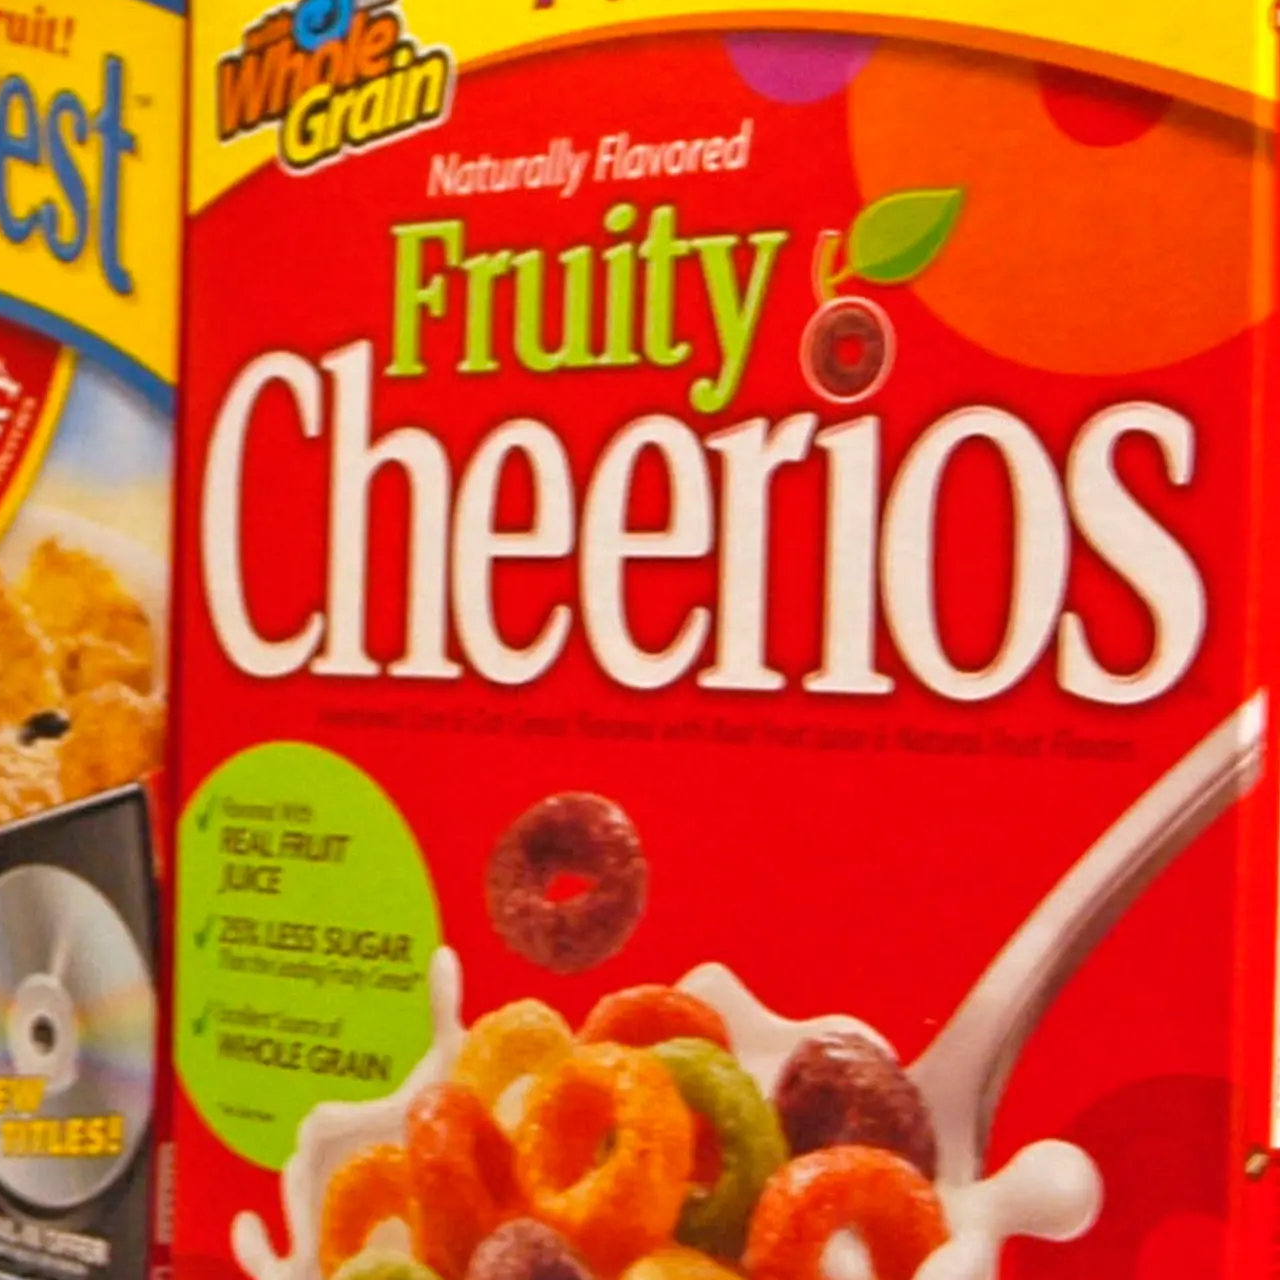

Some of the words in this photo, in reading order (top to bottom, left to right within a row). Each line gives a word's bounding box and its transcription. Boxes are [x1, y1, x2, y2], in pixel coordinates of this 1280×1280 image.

[218, 8, 402, 144] Whole
[282, 42, 452, 171] Grain
[426, 138, 587, 201] Naturally
[593, 120, 753, 188] Flavored
[384, 203, 789, 414] Fruity
[200, 340, 1210, 707] Cheerios
[217, 863, 284, 896] JUICE
[278, 830, 353, 864] FRUIT
[263, 921, 317, 954] LESS
[322, 925, 416, 964] SUGAR
[217, 1032, 300, 1073] WHOLE
[306, 1041, 394, 1082] GRAIN
[0, 1113, 126, 1158] TITLES!
